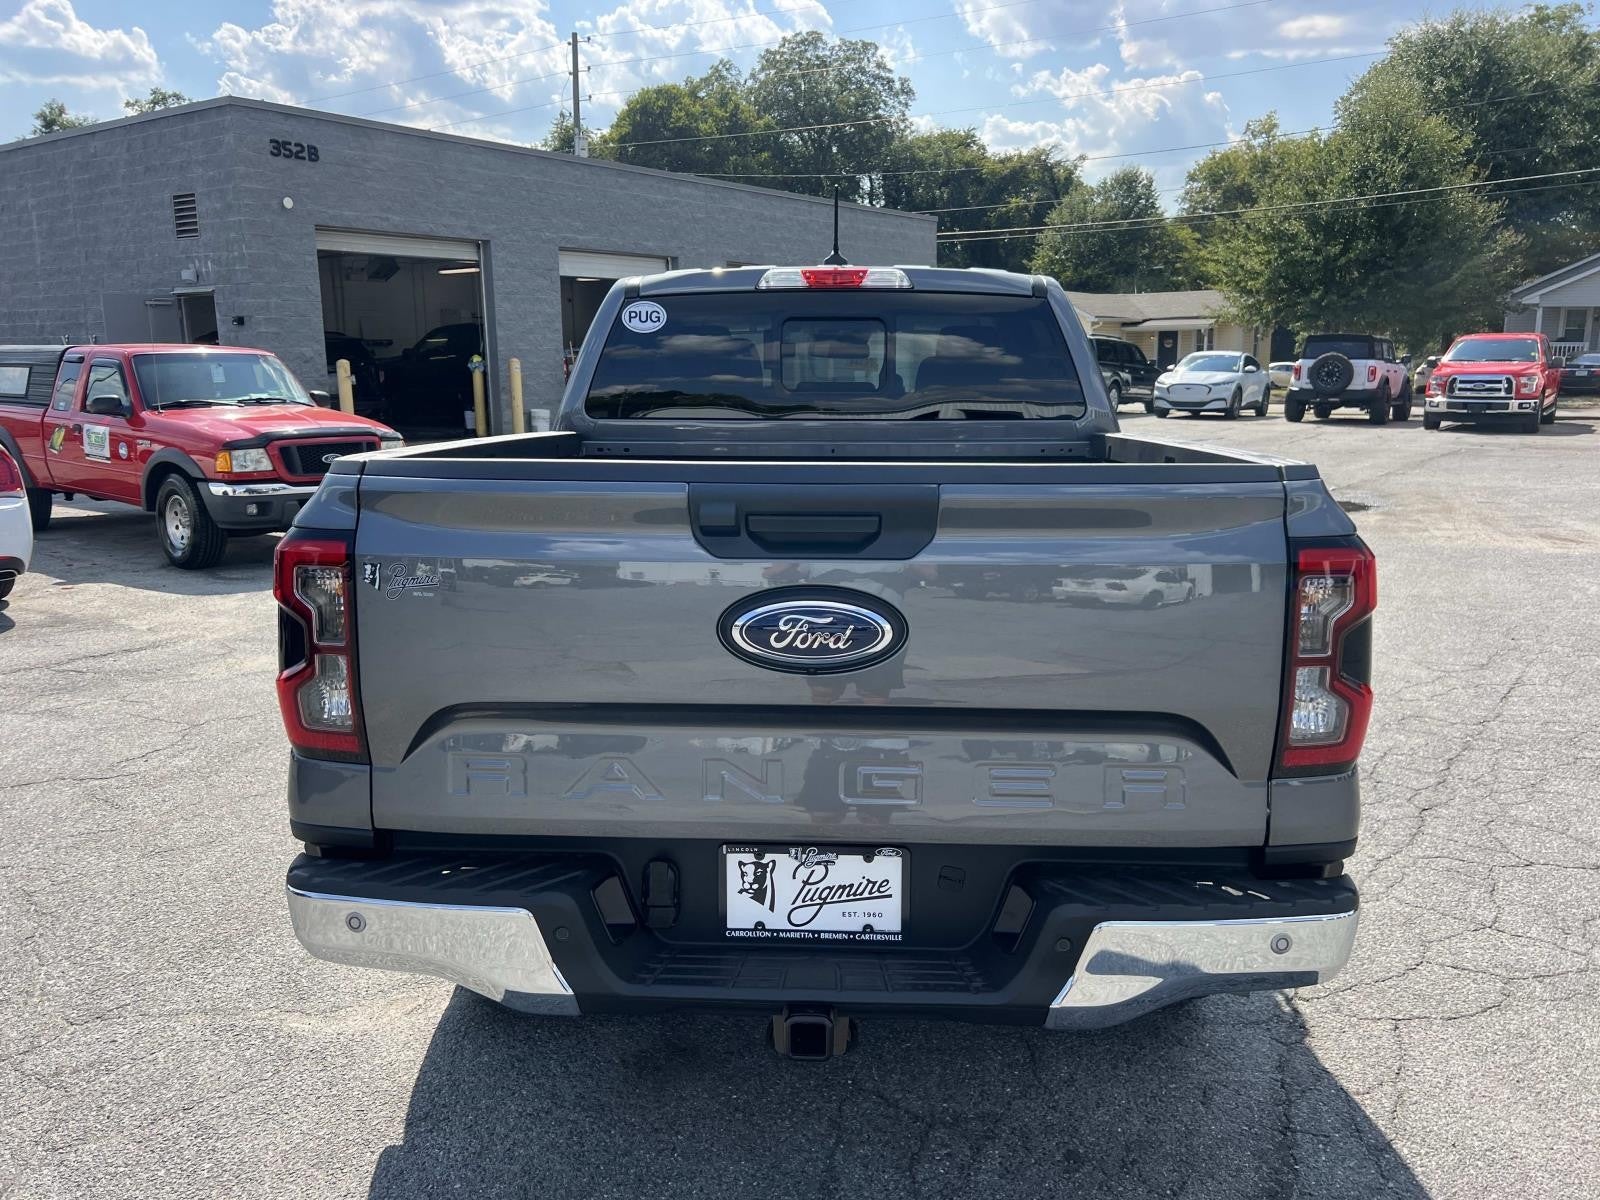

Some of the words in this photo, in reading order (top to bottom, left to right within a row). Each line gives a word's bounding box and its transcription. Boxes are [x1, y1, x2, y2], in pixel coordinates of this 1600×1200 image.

[269, 138, 320, 162] 352B
[628, 310, 661, 324] PUG
[386, 563, 440, 600] Pugmire
[769, 614, 856, 649] Ford
[447, 752, 1188, 810] RANGER
[787, 862, 893, 928] Pugmire
[725, 930, 772, 938] CARROLLTON
[778, 931, 814, 939] MARIETTA
[820, 932, 849, 940] BREMEN
[855, 933, 903, 941] CARTERSVILLE
